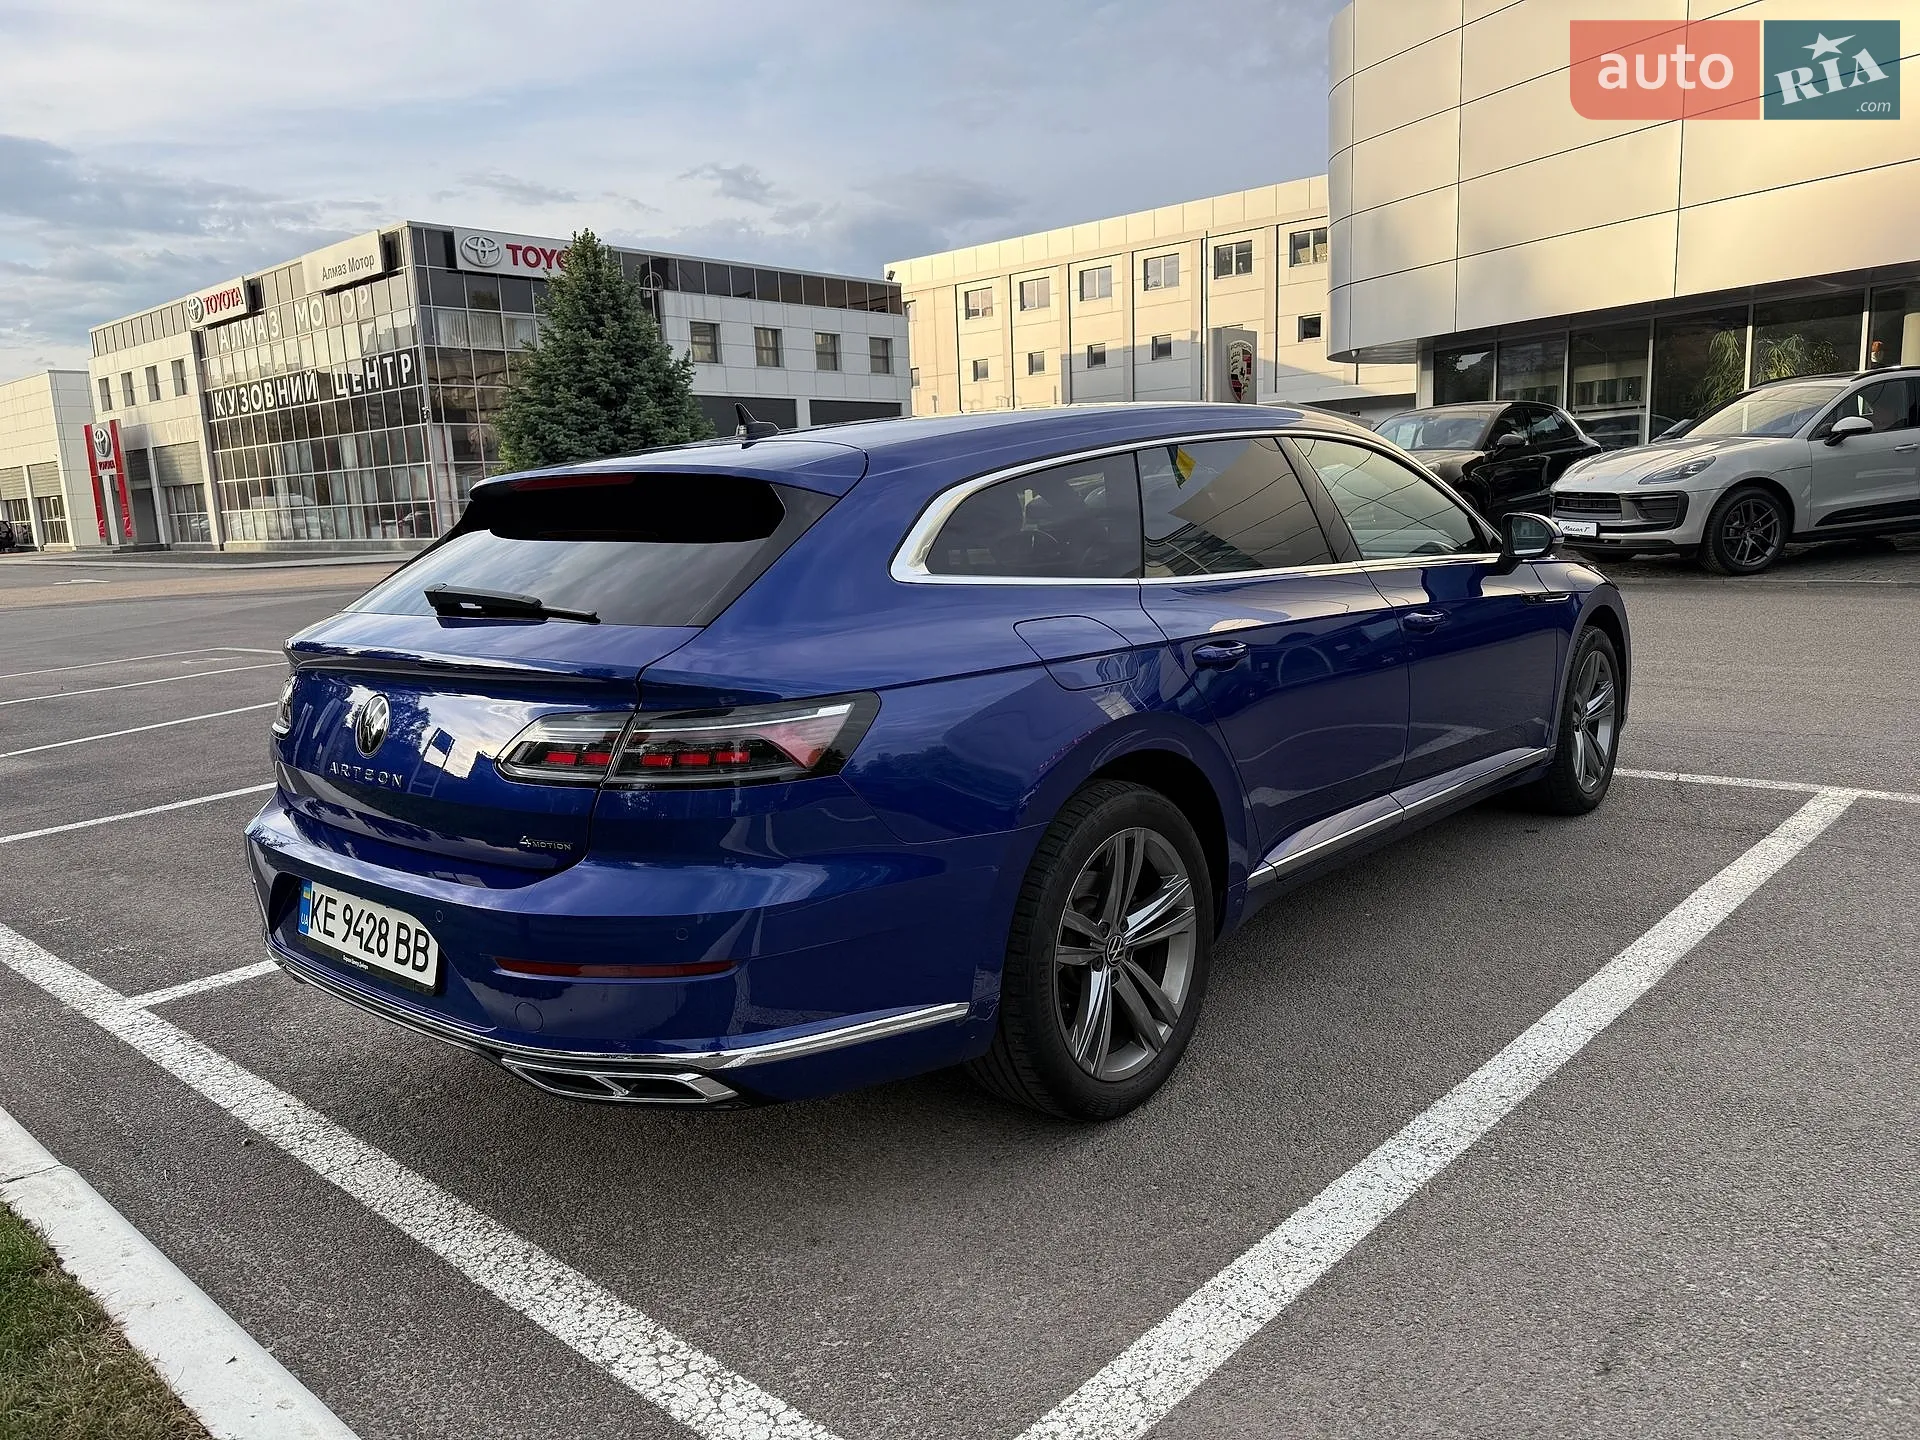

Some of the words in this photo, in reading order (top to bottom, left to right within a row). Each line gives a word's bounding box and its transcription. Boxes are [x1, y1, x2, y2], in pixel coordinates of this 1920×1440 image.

[322, 263, 348, 281] Алмаз
[347, 254, 375, 273] Мотор
[203, 287, 244, 315] TOYOTA
[219, 310, 280, 350] АЛМАЗ
[294, 286, 369, 331] МОТОР
[214, 369, 318, 418] КУЗОВНИЙ
[333, 353, 411, 398] ЦЕНТР
[329, 761, 404, 788] ARTEON
[310, 890, 337, 939] KE
[341, 903, 390, 958] 9428
[393, 921, 430, 973] BB
